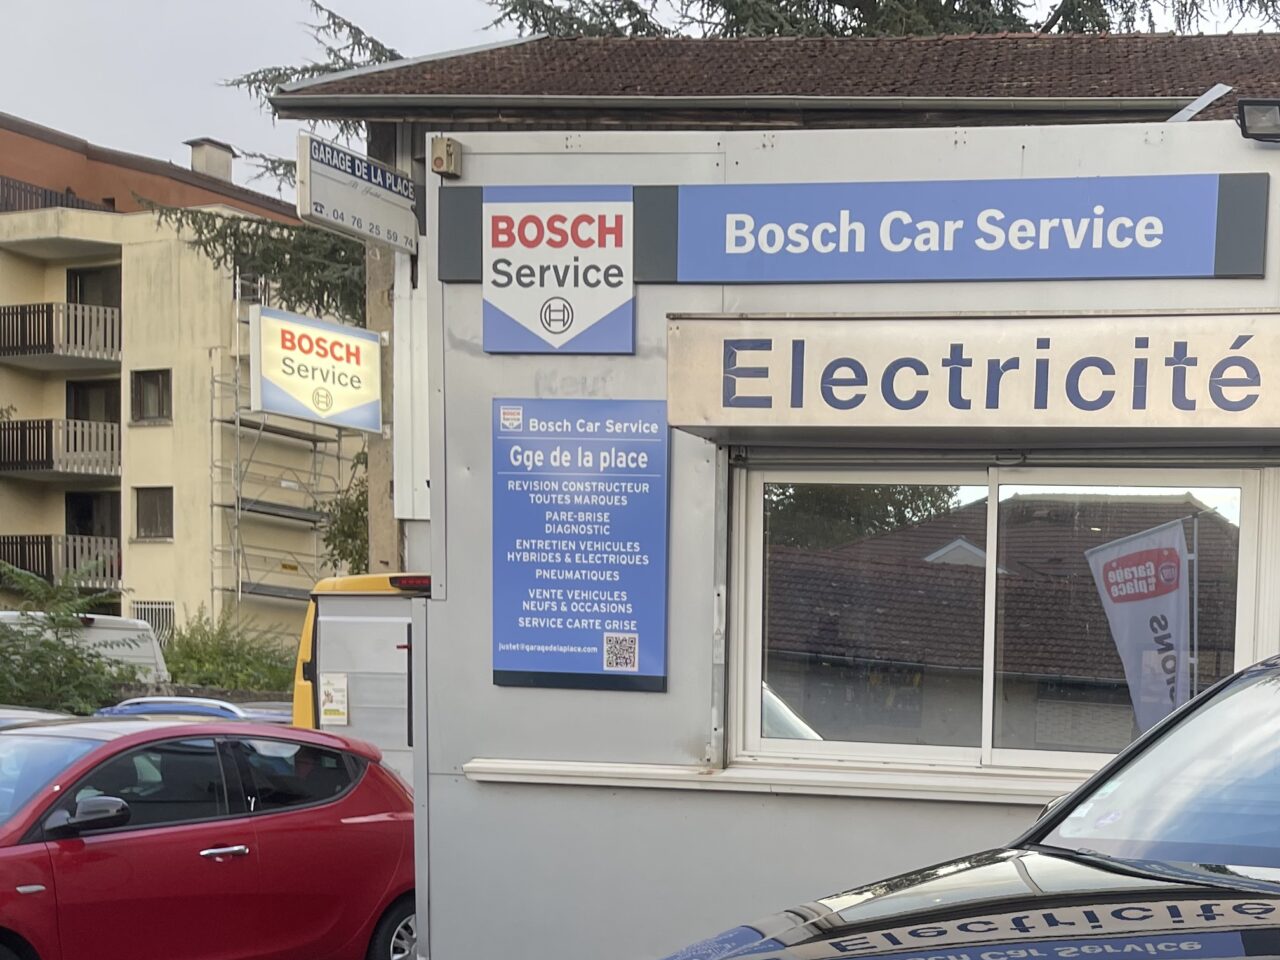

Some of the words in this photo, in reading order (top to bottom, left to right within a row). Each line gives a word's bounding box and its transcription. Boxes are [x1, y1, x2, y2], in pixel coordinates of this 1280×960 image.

[312, 141, 352, 173] GARAGE
[355, 158, 368, 180] DE
[371, 165, 383, 187] LA
[386, 171, 415, 199] PLACE
[333, 209, 345, 222] 04
[351, 216, 363, 229] 76
[369, 223, 381, 236] 25
[387, 230, 398, 242] 59
[403, 236, 413, 248] 74
[491, 214, 623, 249] BOSCH
[725, 210, 865, 255] Bosch
[879, 210, 963, 252] Car
[974, 205, 1164, 251] Service
[491, 256, 624, 289] Service
[281, 328, 361, 366] BOSCH
[282, 357, 362, 389] Service
[722, 334, 1262, 412] Electricité
[529, 418, 571, 433] Bosch
[576, 419, 601, 433] Car
[605, 419, 659, 434] Service
[509, 445, 544, 471] Gge
[550, 446, 571, 467] de
[577, 446, 593, 468] la
[600, 447, 648, 472] place
[508, 480, 559, 492] REVISION
[562, 481, 650, 494] CONSTRUCTEUR
[529, 494, 571, 505] TOUTES
[574, 494, 628, 506] MARQUES
[545, 512, 610, 523] PARE-BRISE
[545, 524, 610, 535] DIAGNOSTIC
[516, 539, 576, 551] ENTRETIEN
[579, 540, 640, 552] VEHICULES
[507, 552, 562, 564] HYBRIDES
[565, 553, 572, 564] &
[575, 553, 649, 565] ELECTRIQUES
[535, 569, 620, 581] PNEUMATIQUES
[528, 589, 564, 600] VENTE
[566, 589, 627, 601] VEHICULES
[522, 601, 557, 612] NEUFS
[560, 602, 568, 612] &
[571, 602, 633, 614] OCCASIONS
[518, 617, 563, 629] SERVICE
[566, 618, 602, 630] CARTE
[605, 619, 637, 630] GRISE
